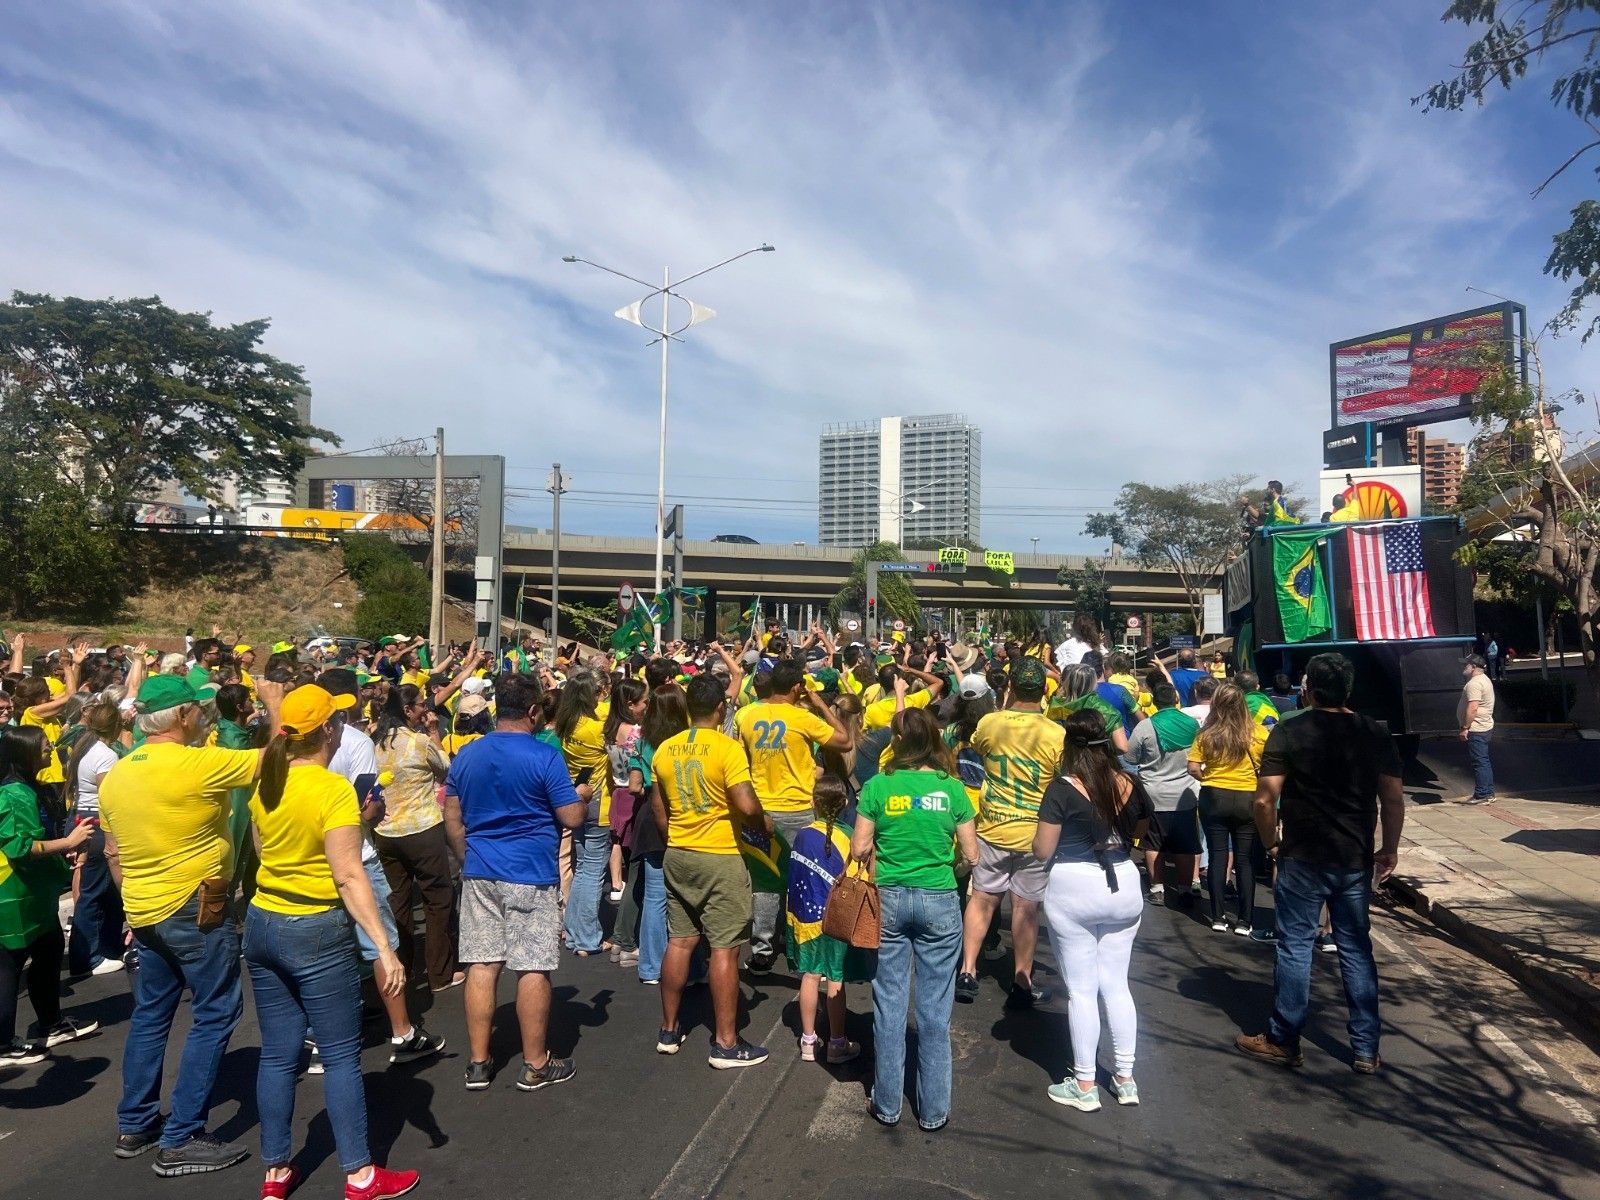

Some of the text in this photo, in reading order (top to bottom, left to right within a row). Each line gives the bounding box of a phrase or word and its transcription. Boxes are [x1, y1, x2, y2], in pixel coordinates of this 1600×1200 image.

[941, 550, 965, 559] FORA
[986, 552, 1011, 560] FORA
[753, 719, 788, 749] 22
[667, 742, 711, 757] NEYMAR JR
[673, 759, 711, 814] 10
[887, 794, 948, 812] BRASIL
[803, 858, 835, 883] PROGRE
